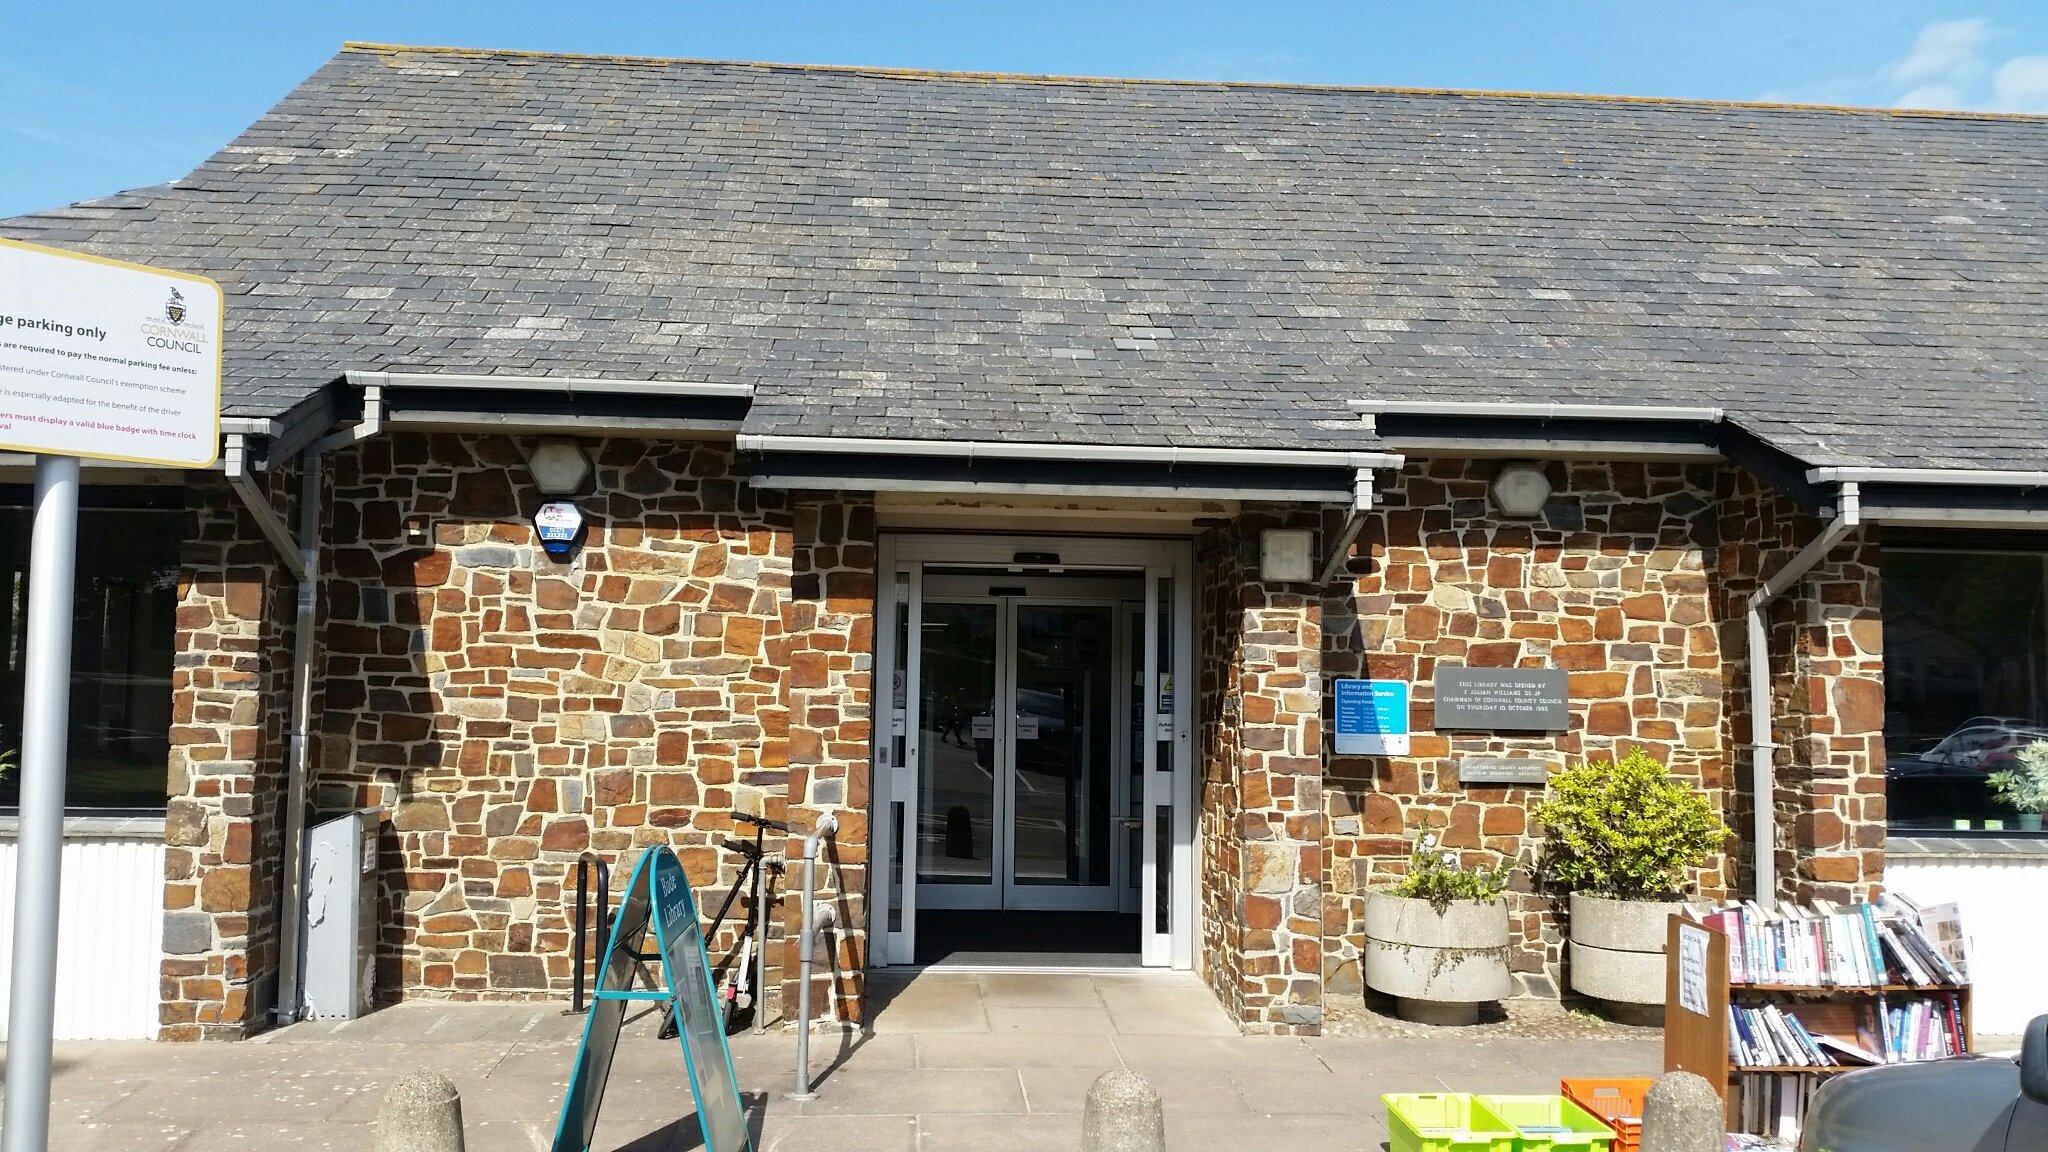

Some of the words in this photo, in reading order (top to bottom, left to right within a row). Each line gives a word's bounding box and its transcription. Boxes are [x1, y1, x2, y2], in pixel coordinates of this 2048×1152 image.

[18, 318, 72, 336] parking
[77, 326, 106, 341] only
[140, 324, 208, 343] CORNWALL
[147, 336, 202, 354] COUNCIL
[20, 344, 55, 354] required
[68, 351, 82, 359] pay
[84, 352, 97, 360] the
[99, 356, 126, 365] normal
[128, 360, 157, 370] parking
[172, 366, 197, 375] unless:
[26, 366, 49, 377] under
[51, 371, 84, 381] Cornwall
[86, 376, 118, 386] Council's
[120, 381, 158, 391] exemption
[160, 385, 186, 395] scheme
[12, 390, 50, 401] especially
[53, 395, 84, 405] adapted
[98, 400, 110, 408] the
[112, 400, 137, 411] benefit
[161, 407, 181, 416] driver
[15, 414, 36, 422] must
[38, 415, 68, 426] display
[76, 420, 95, 428] valid
[97, 422, 114, 430] blue
[116, 424, 140, 434] badge
[142, 427, 158, 435] with
[178, 431, 196, 439] clock
[661, 872, 676, 897] Bude
[664, 899, 686, 928] Library
